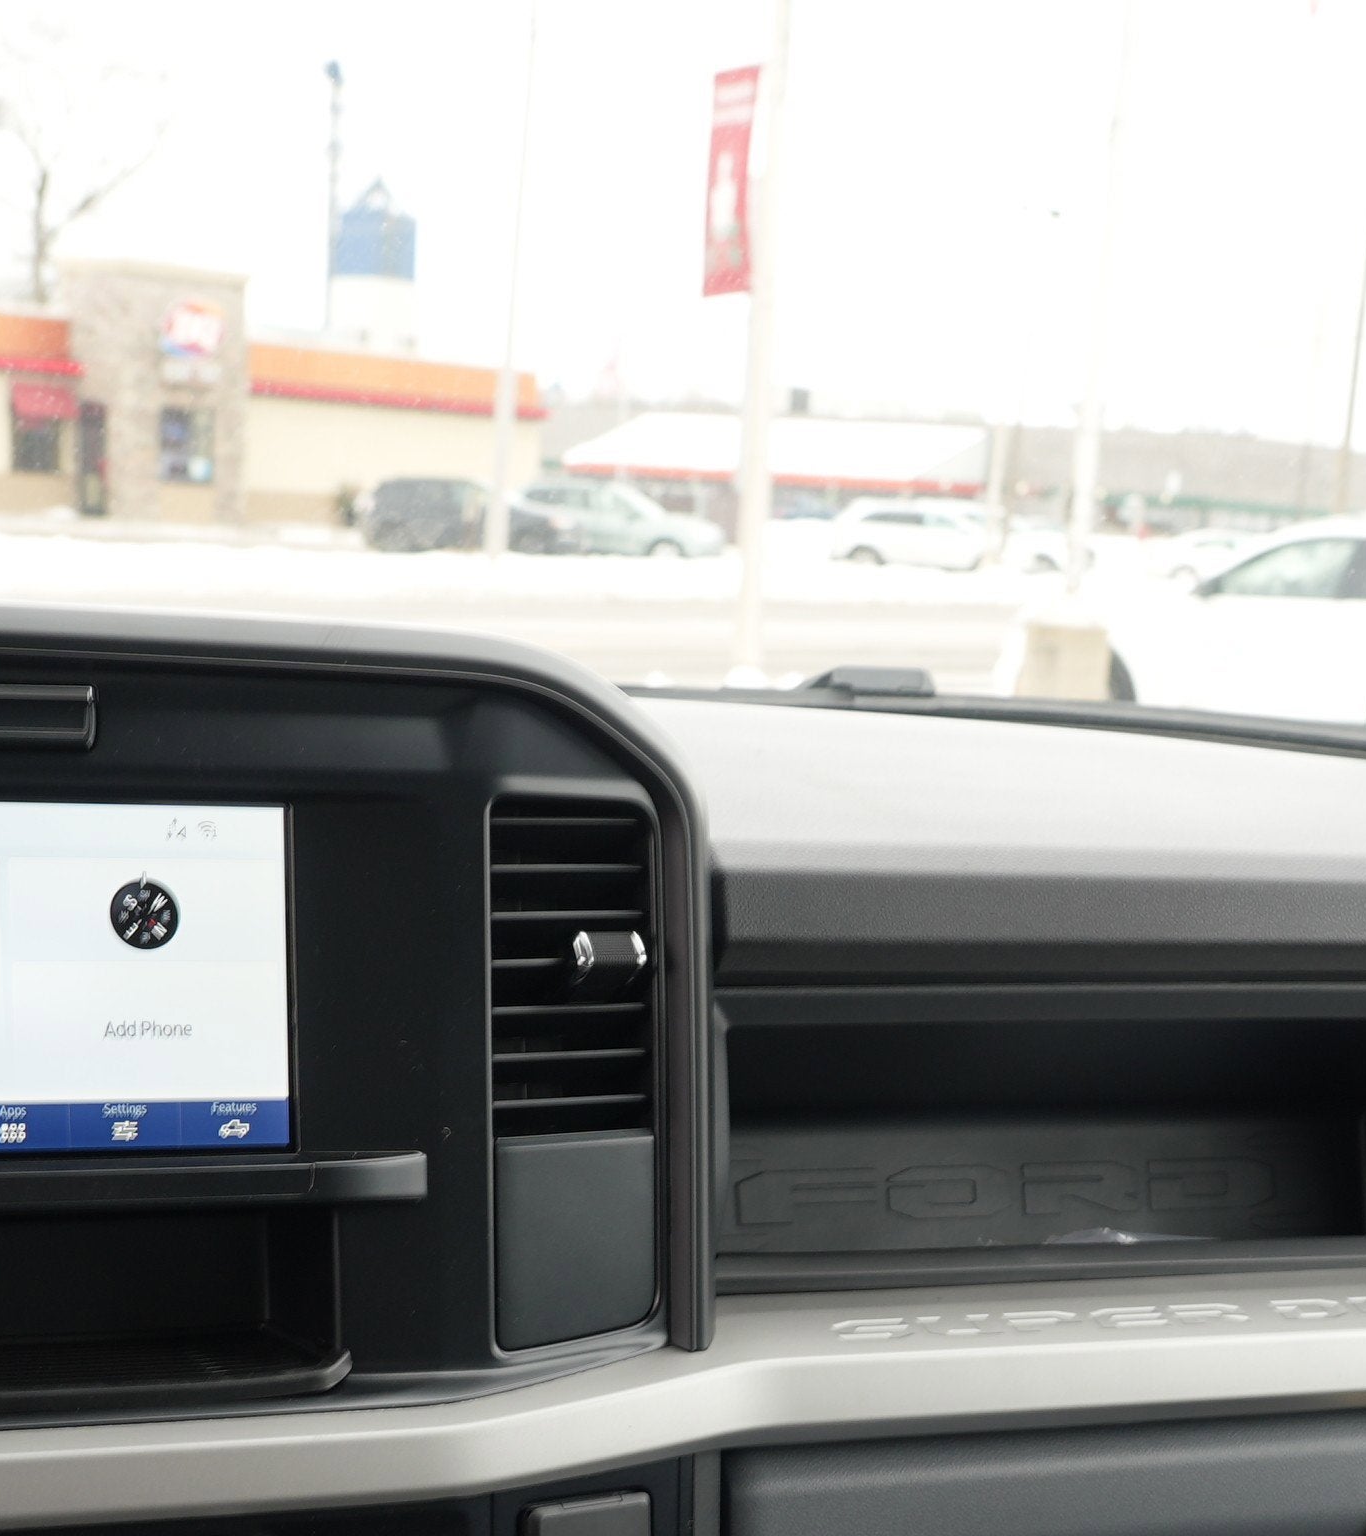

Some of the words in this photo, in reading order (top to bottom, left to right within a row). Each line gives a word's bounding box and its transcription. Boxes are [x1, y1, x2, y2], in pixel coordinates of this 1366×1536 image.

[122, 893, 138, 912] S
[146, 892, 169, 915] W
[123, 922, 139, 941] E
[151, 921, 168, 941] N
[104, 1019, 137, 1039] Add
[139, 1019, 193, 1038] Phone
[102, 1102, 148, 1118] Settings
[212, 1100, 258, 1116] Features
[736, 1157, 1276, 1227] FORD
[832, 1301, 1249, 1342] SUPER
